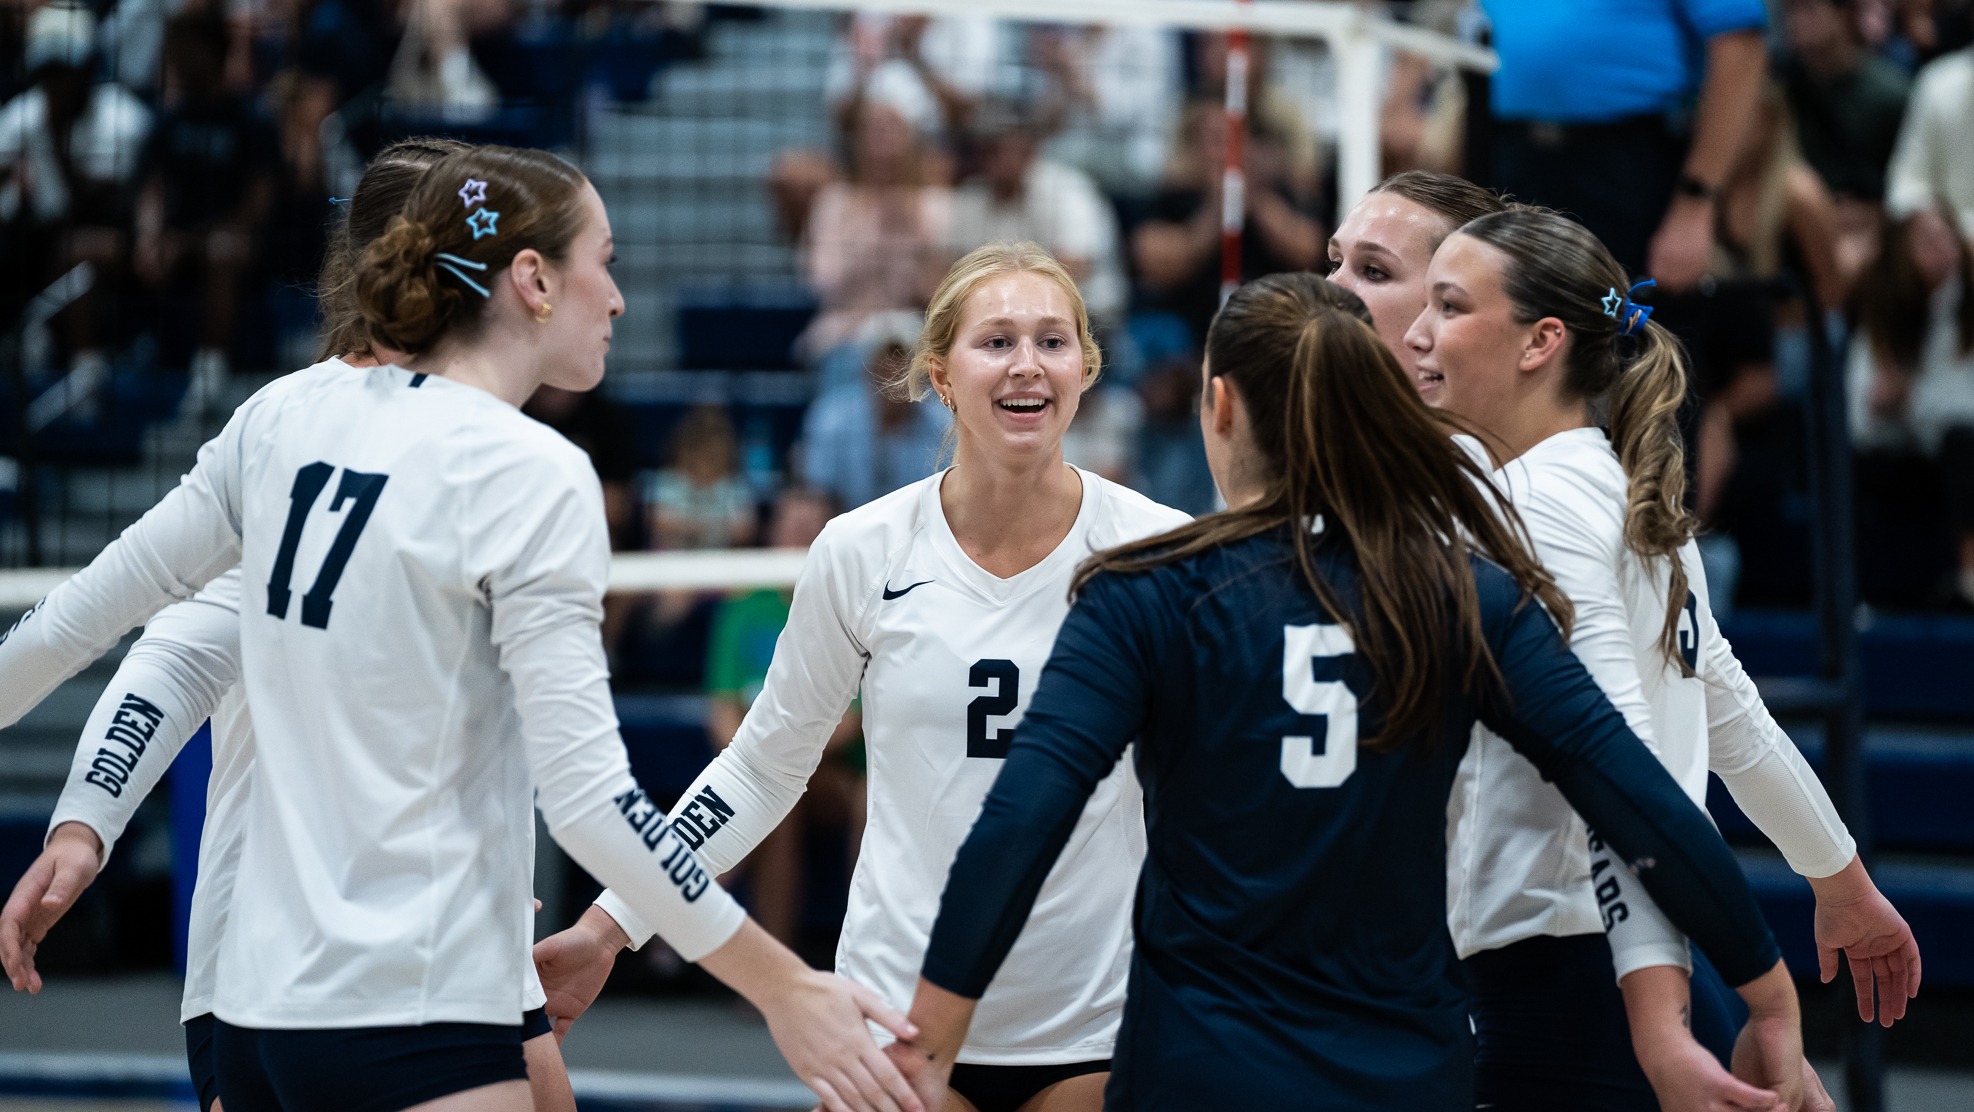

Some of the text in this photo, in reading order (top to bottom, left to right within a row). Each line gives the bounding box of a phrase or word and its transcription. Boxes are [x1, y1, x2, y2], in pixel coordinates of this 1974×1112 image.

[266, 461, 390, 630] 17
[85, 693, 164, 798] GOLDEN
[967, 659, 1020, 758] 2
[1280, 624, 1358, 788] 5
[672, 784, 735, 852] DEN
